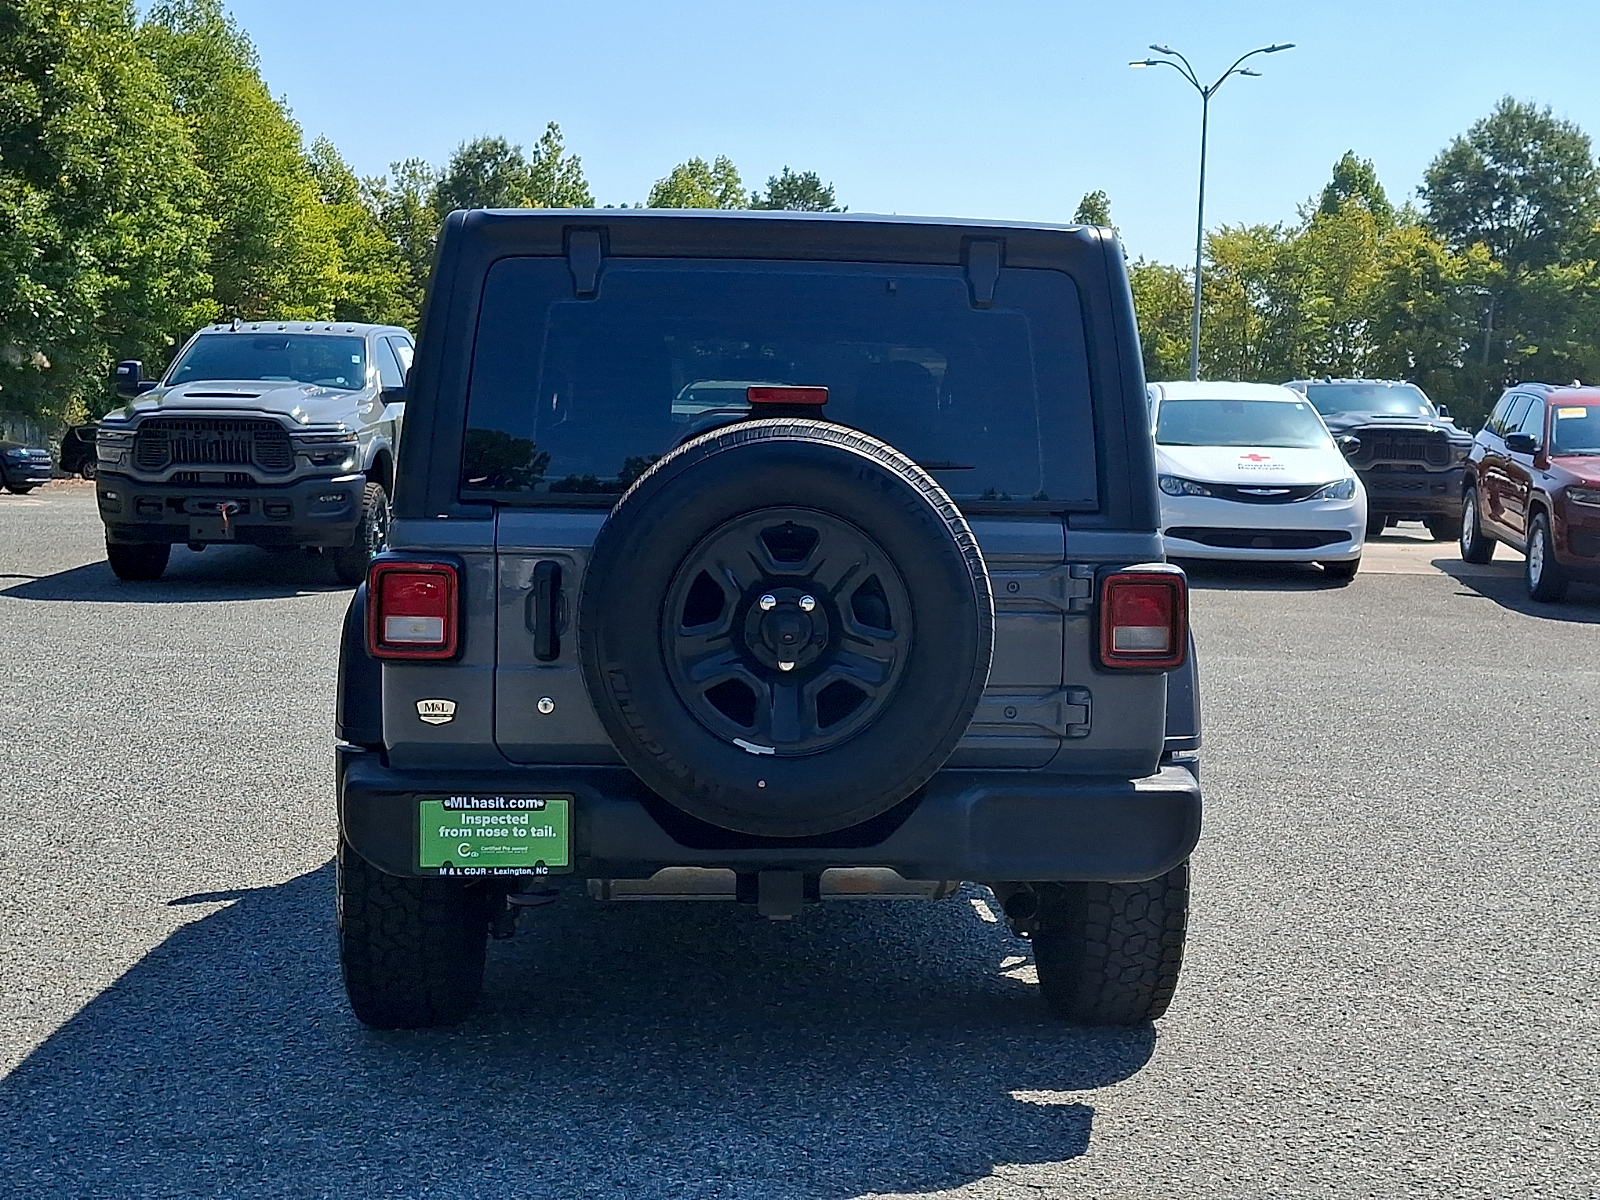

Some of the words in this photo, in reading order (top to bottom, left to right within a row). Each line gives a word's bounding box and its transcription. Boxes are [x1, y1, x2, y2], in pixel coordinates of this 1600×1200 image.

[424, 702, 449, 712] M&L
[450, 796, 538, 809] MLhasit.com
[461, 813, 529, 827] Inspected
[439, 826, 472, 838] from
[476, 828, 509, 838] nose
[512, 826, 527, 838] to
[530, 825, 557, 838] tail.
[439, 867, 447, 876] M
[449, 867, 455, 876] &
[457, 867, 462, 876] L
[464, 867, 487, 876] CDJR
[494, 867, 534, 876] Lexington,
[536, 867, 549, 876] NC
